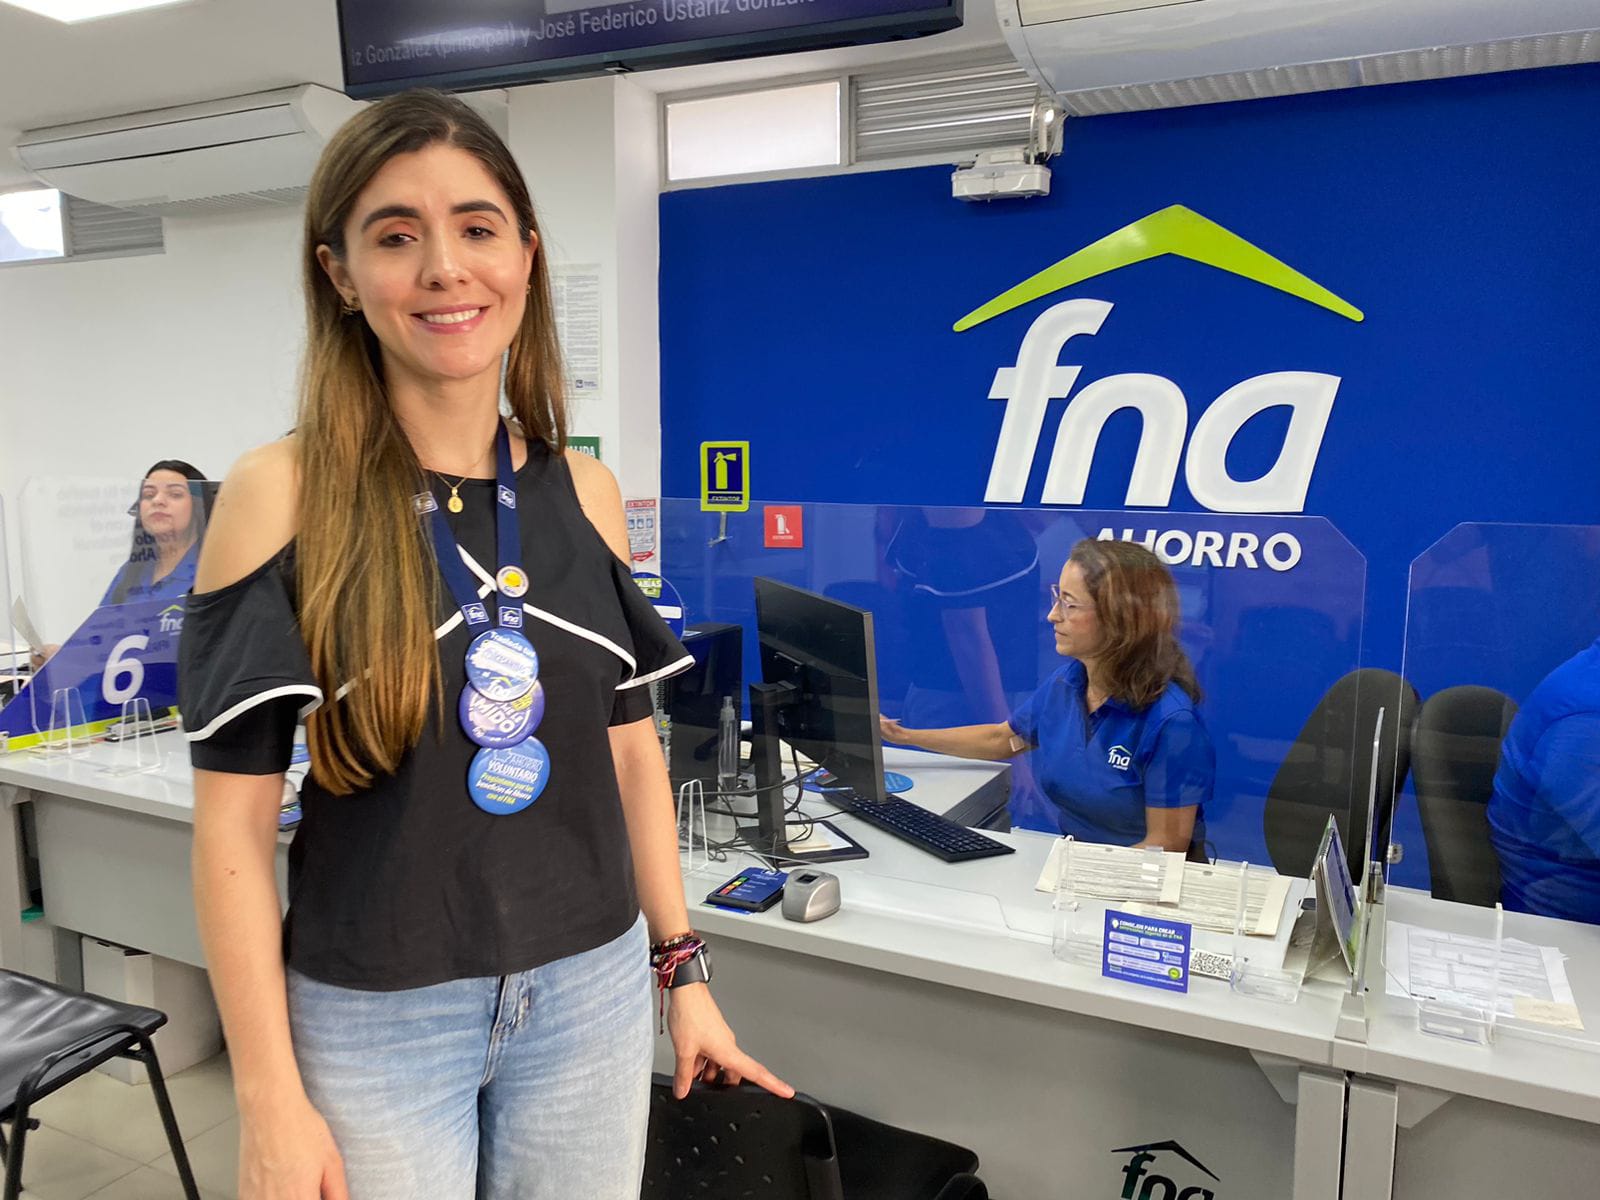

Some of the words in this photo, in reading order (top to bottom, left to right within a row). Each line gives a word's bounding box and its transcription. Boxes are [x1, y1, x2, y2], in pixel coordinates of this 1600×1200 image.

[520, 26, 531, 47] y
[535, 17, 575, 40] José
[580, 6, 657, 35] Federico
[983, 298, 1342, 513] fna
[102, 635, 150, 705] 6
[488, 760, 539, 784] VOLUNTARIO
[1107, 749, 1131, 767] fna
[1144, 924, 1158, 932] PARA
[1158, 927, 1176, 935] CREAR
